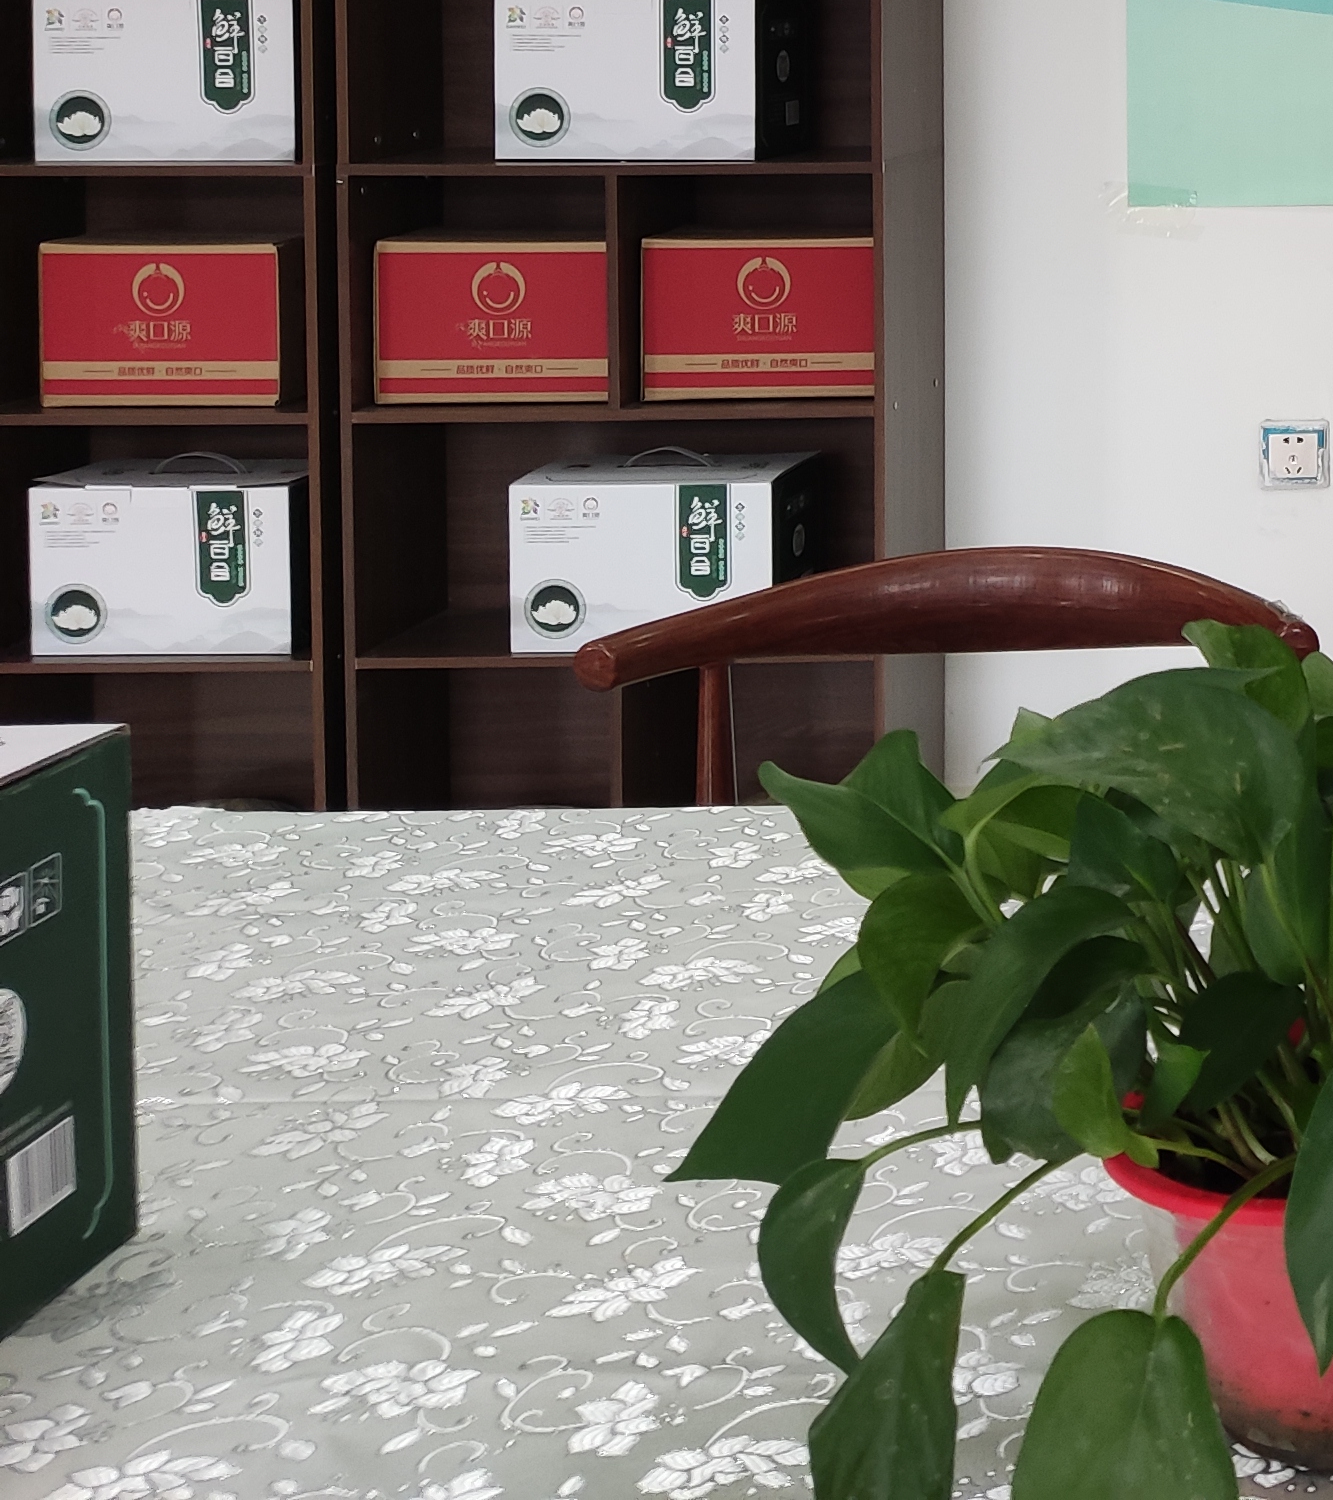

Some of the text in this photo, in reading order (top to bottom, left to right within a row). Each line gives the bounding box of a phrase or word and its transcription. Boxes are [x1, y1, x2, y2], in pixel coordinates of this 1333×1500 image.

[211, 9, 245, 88] 鲜百合
[672, 8, 707, 87] 鲜百合
[128, 320, 192, 342] 爽口源
[467, 318, 533, 341] 爽口源
[731, 313, 798, 336] 爽口源
[206, 502, 241, 582] 鲜百合
[688, 497, 723, 576] 鲜百合
